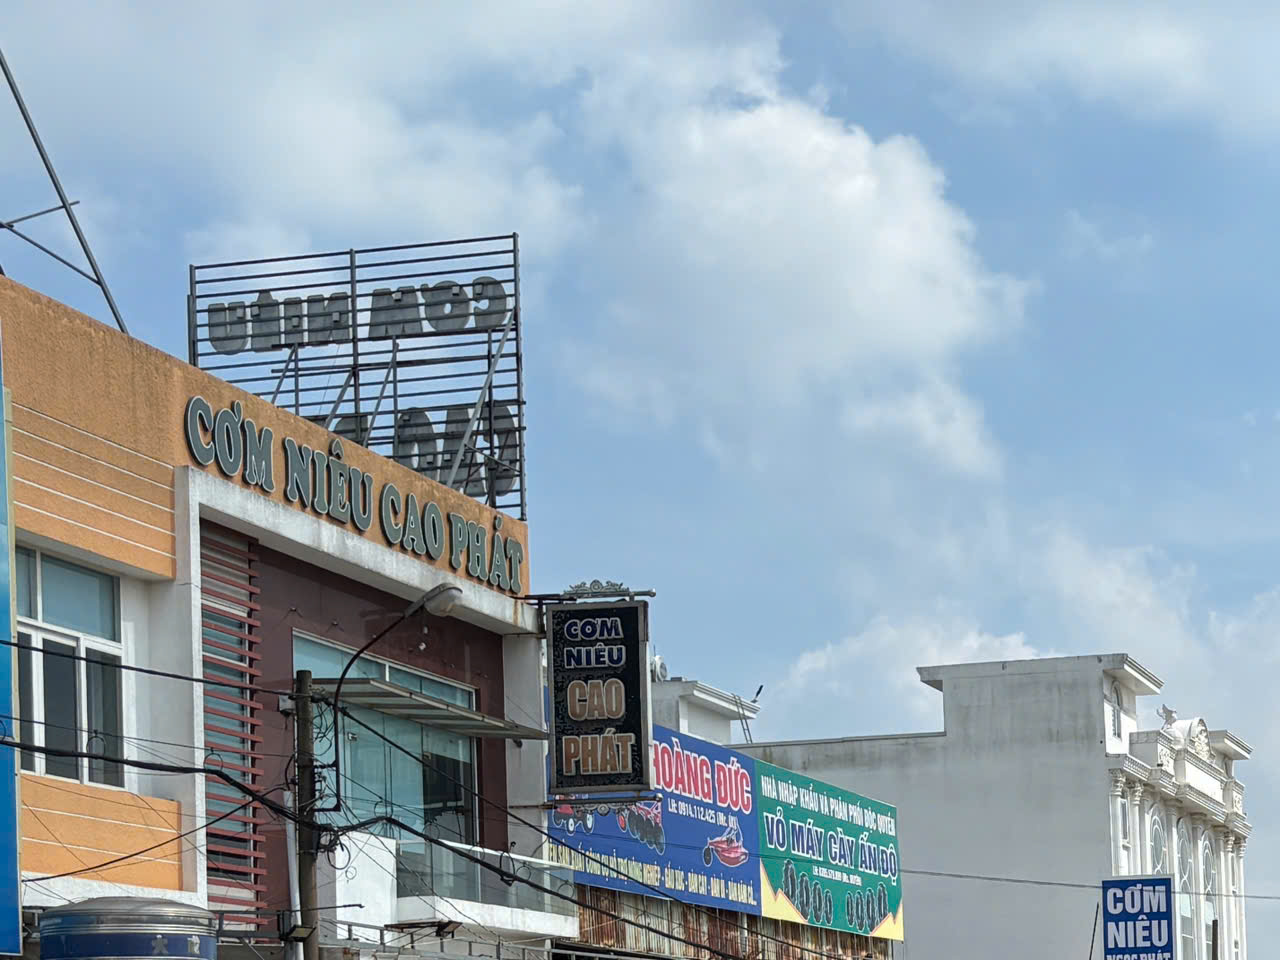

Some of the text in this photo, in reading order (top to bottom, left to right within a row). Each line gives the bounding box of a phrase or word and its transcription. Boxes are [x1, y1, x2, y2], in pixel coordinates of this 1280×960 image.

[184, 396, 524, 595] CƠM NIÊU CAO PHÁT
[564, 617, 624, 641] CƠM
[564, 642, 627, 669] NIÊU
[567, 678, 626, 721] CAO
[562, 728, 636, 776] PHÁT
[714, 756, 752, 815] ĐỨC
[761, 774, 778, 800] NHÀ
[777, 780, 799, 808] NHẬP
[799, 783, 819, 813] KHẨU
[819, 791, 830, 816] VÀ
[829, 796, 848, 822] PHÂN
[763, 806, 898, 886] VỎ MÁY CÀY ẤN ĐỘ
[1106, 884, 1167, 914] CƠM
[1107, 915, 1169, 949] NIÊU
